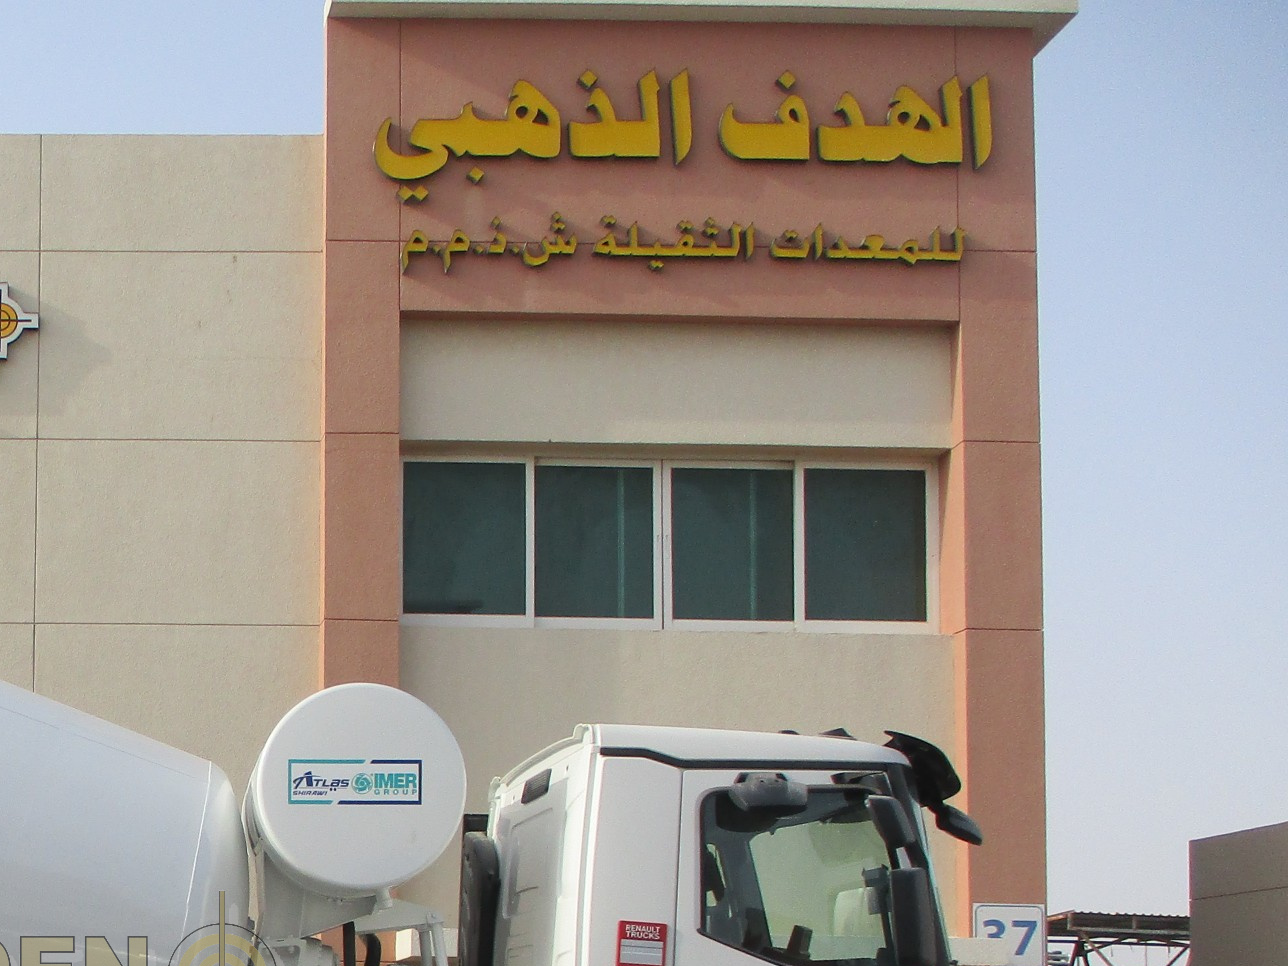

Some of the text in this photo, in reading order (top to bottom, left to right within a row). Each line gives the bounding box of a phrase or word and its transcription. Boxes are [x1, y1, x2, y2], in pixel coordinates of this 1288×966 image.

[373, 69, 993, 202] الهدف الذهبي
[593, 215, 756, 270] الثقيلة
[769, 222, 967, 266] للمعدات
[374, 773, 418, 789] IMER
[625, 924, 661, 934] RENAULT
[625, 931, 661, 940] TRUCKS
